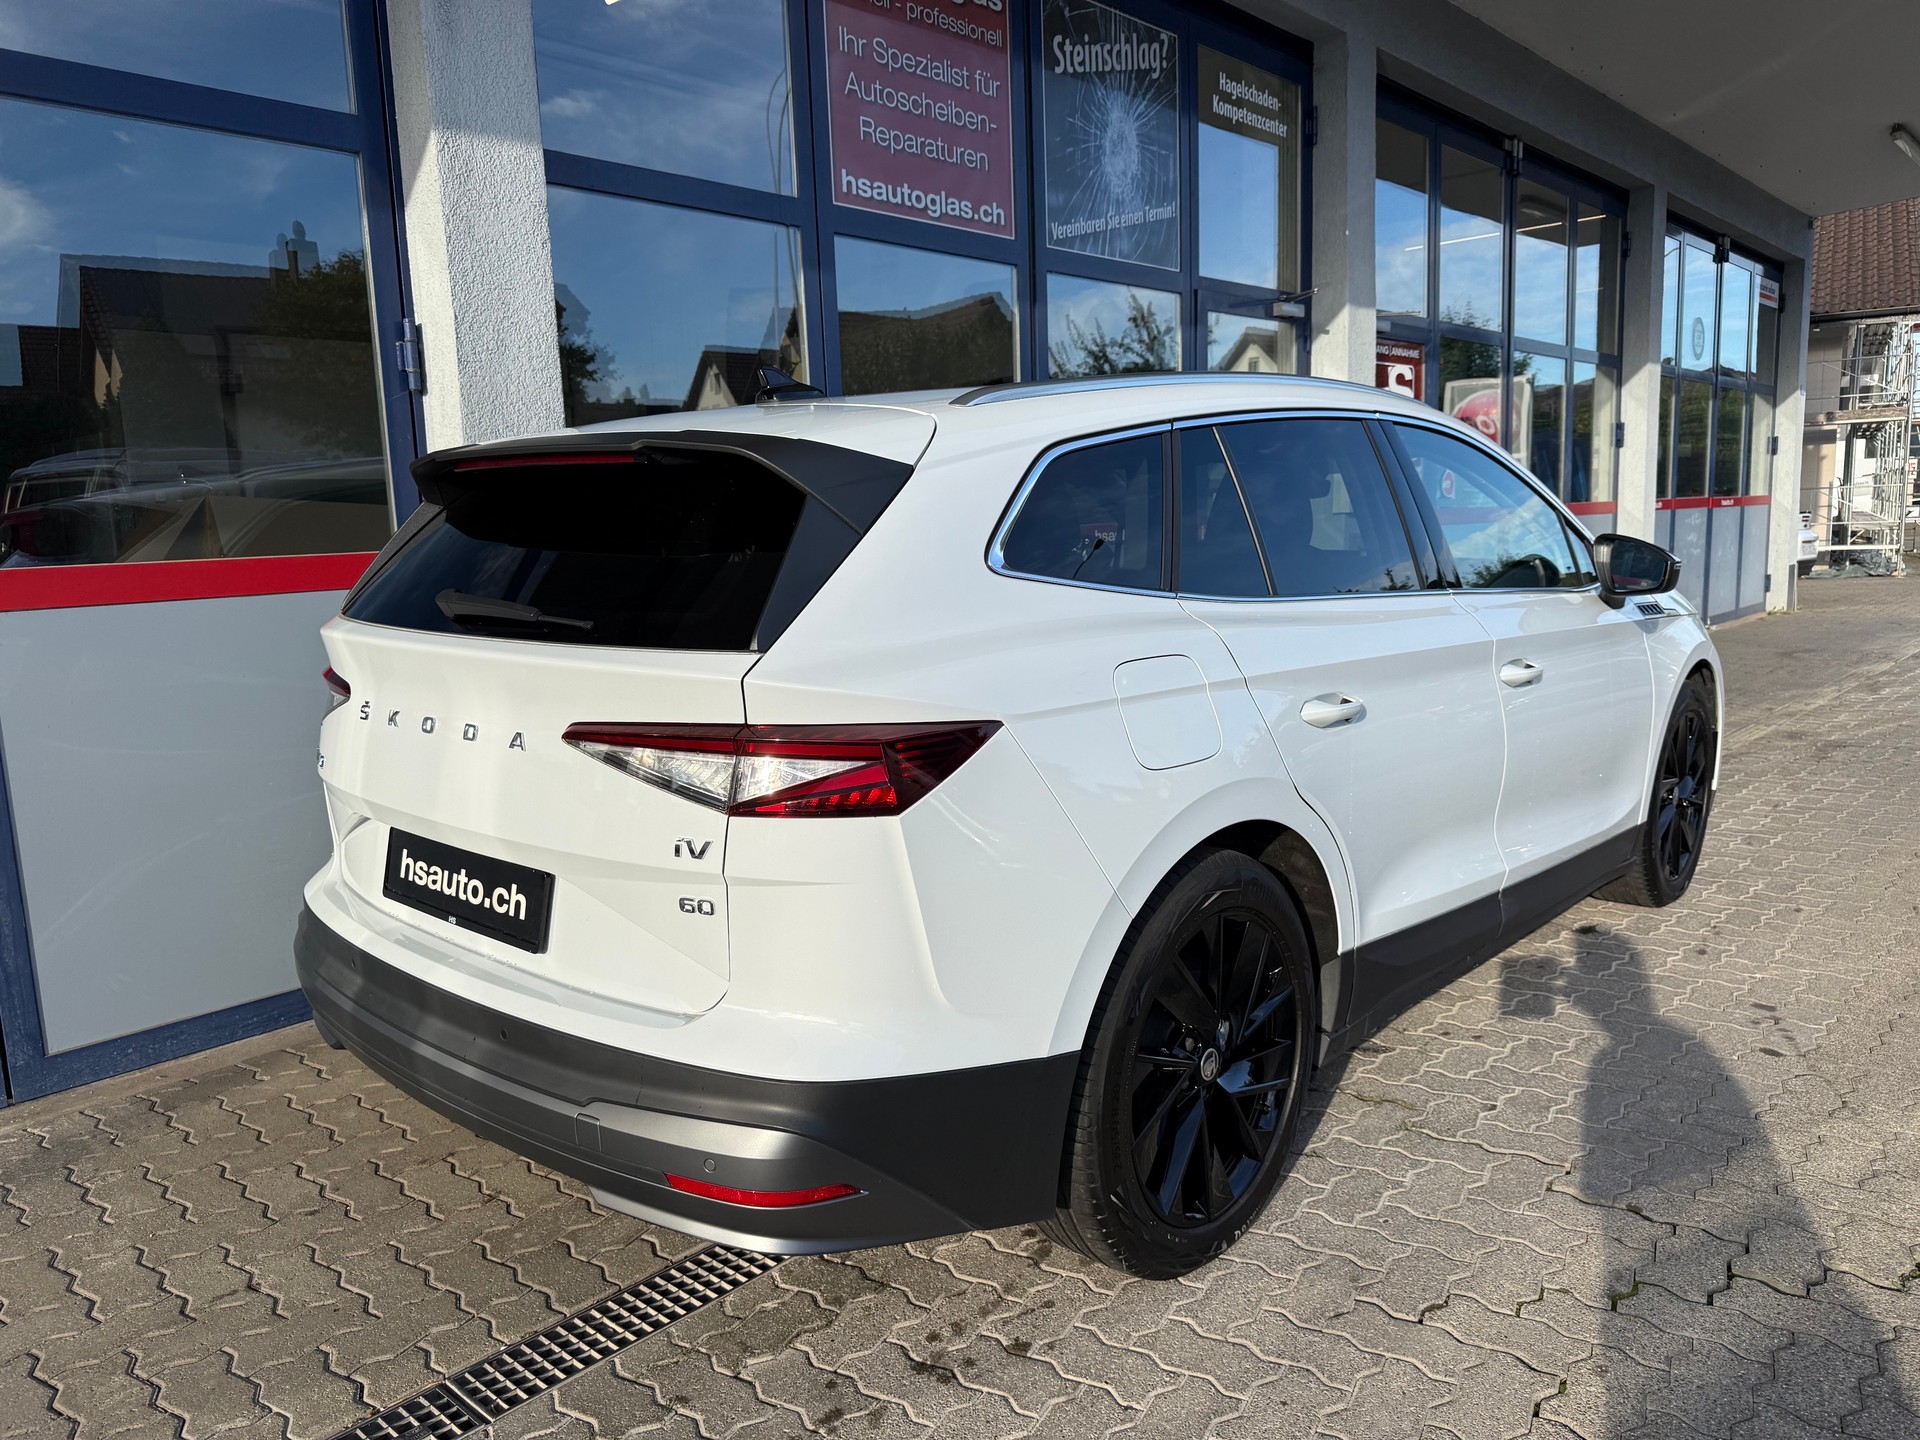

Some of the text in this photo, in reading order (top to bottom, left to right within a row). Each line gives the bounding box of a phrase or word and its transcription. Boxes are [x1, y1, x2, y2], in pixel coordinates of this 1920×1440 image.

[906, 2, 1003, 47] professionell
[838, 25, 1001, 98] Ihr Spezialist für
[1052, 32, 1169, 80] Steinschlag?
[844, 71, 998, 134] Autoscheiben-
[1219, 71, 1282, 112] Hagelschaden-
[1212, 94, 1288, 138] Kompetenzcenter
[859, 115, 989, 171] Reparaturen
[841, 168, 1006, 226] hsautoglas.ch
[1051, 201, 1176, 241] Vereinbaren Sie einen Termin!
[1391, 347, 1420, 359] ANNAHME
[359, 700, 527, 752] ŠKODA
[400, 848, 527, 920] hsauto.ch
[678, 897, 716, 916] 60
